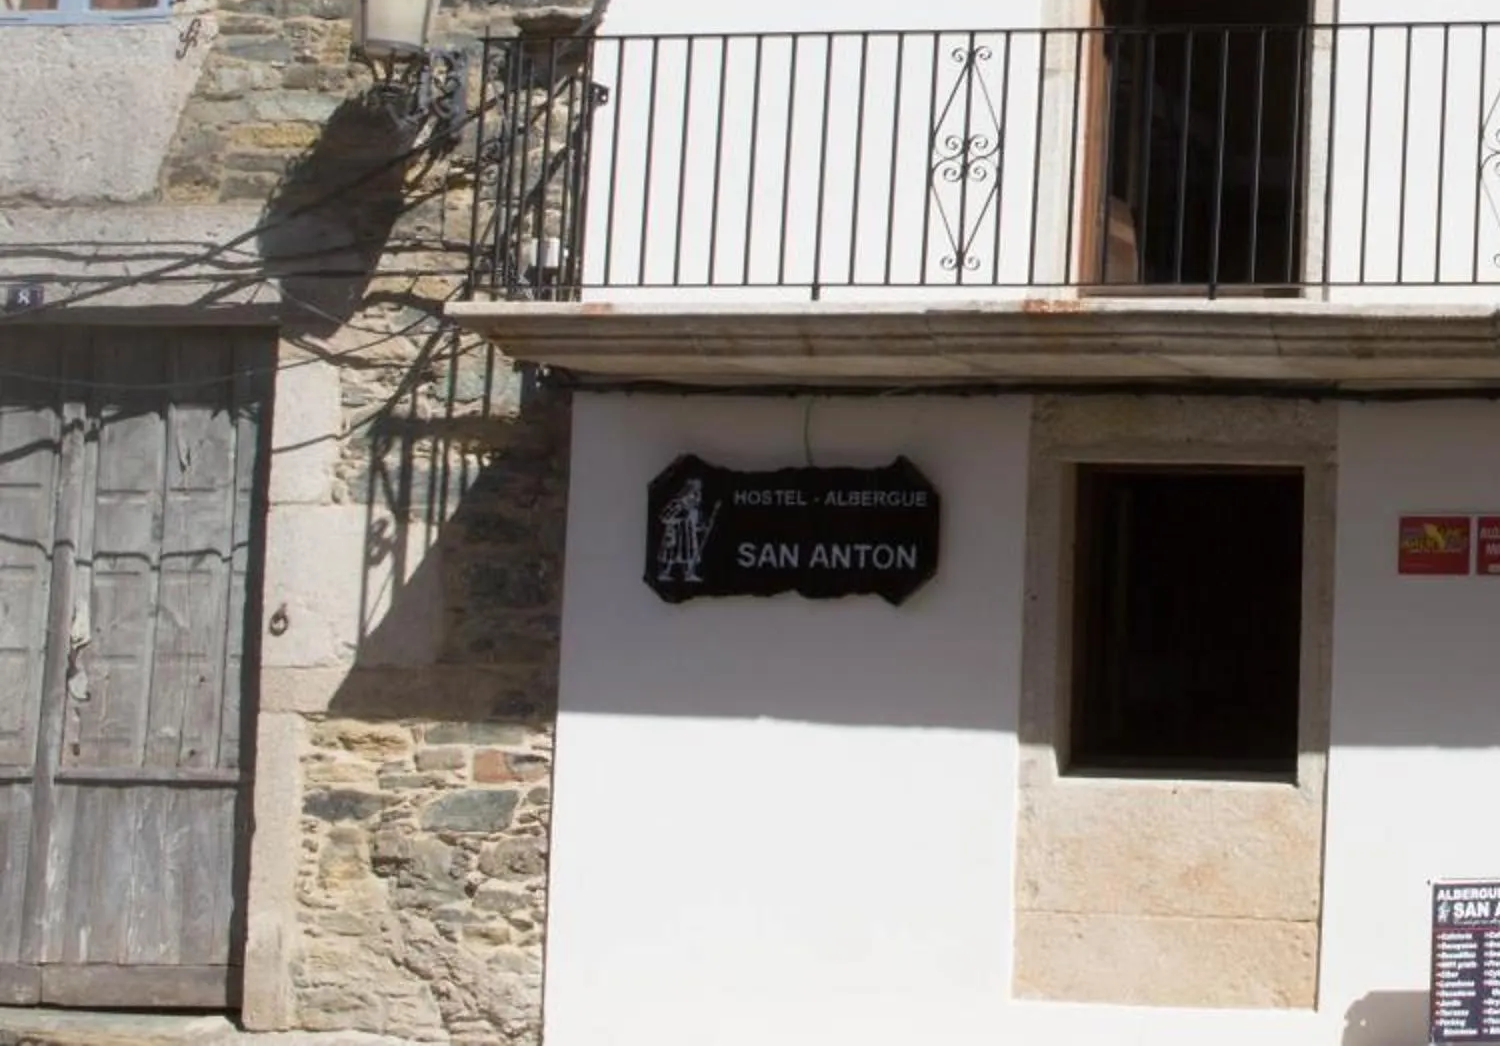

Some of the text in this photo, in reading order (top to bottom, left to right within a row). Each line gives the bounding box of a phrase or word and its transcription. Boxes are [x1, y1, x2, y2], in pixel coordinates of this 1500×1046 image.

[733, 490, 807, 506] HOSTEL
[823, 490, 928, 506] ALBERGUE
[737, 542, 918, 570] SAN ANTON
[1453, 902, 1491, 919] SAN
